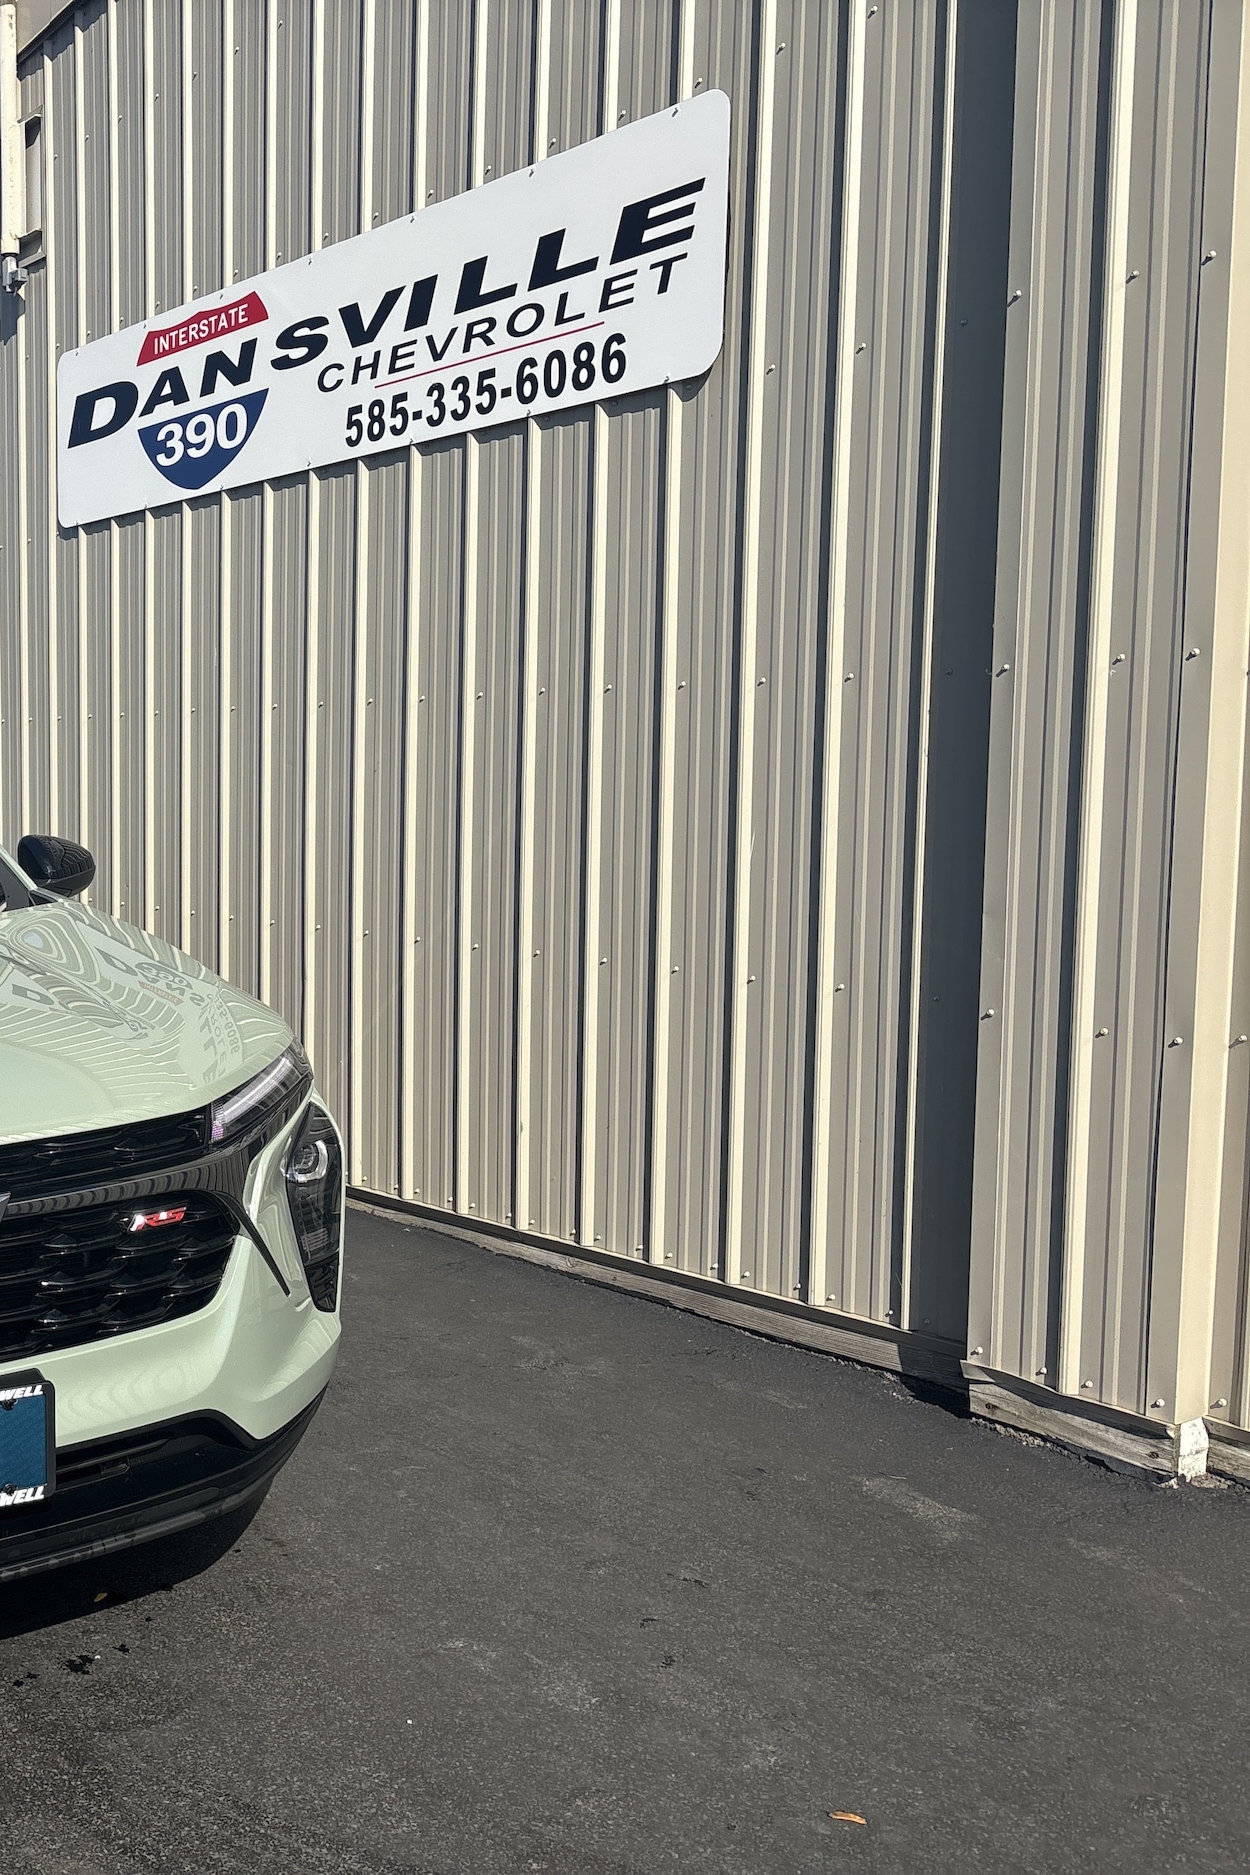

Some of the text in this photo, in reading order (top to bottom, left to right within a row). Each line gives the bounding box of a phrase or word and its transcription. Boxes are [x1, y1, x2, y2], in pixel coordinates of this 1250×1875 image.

[153, 301, 251, 356] INTERSTATE
[317, 253, 688, 392] CHEVROLET
[345, 333, 626, 447] 585-335-6086
[155, 403, 248, 467] 390
